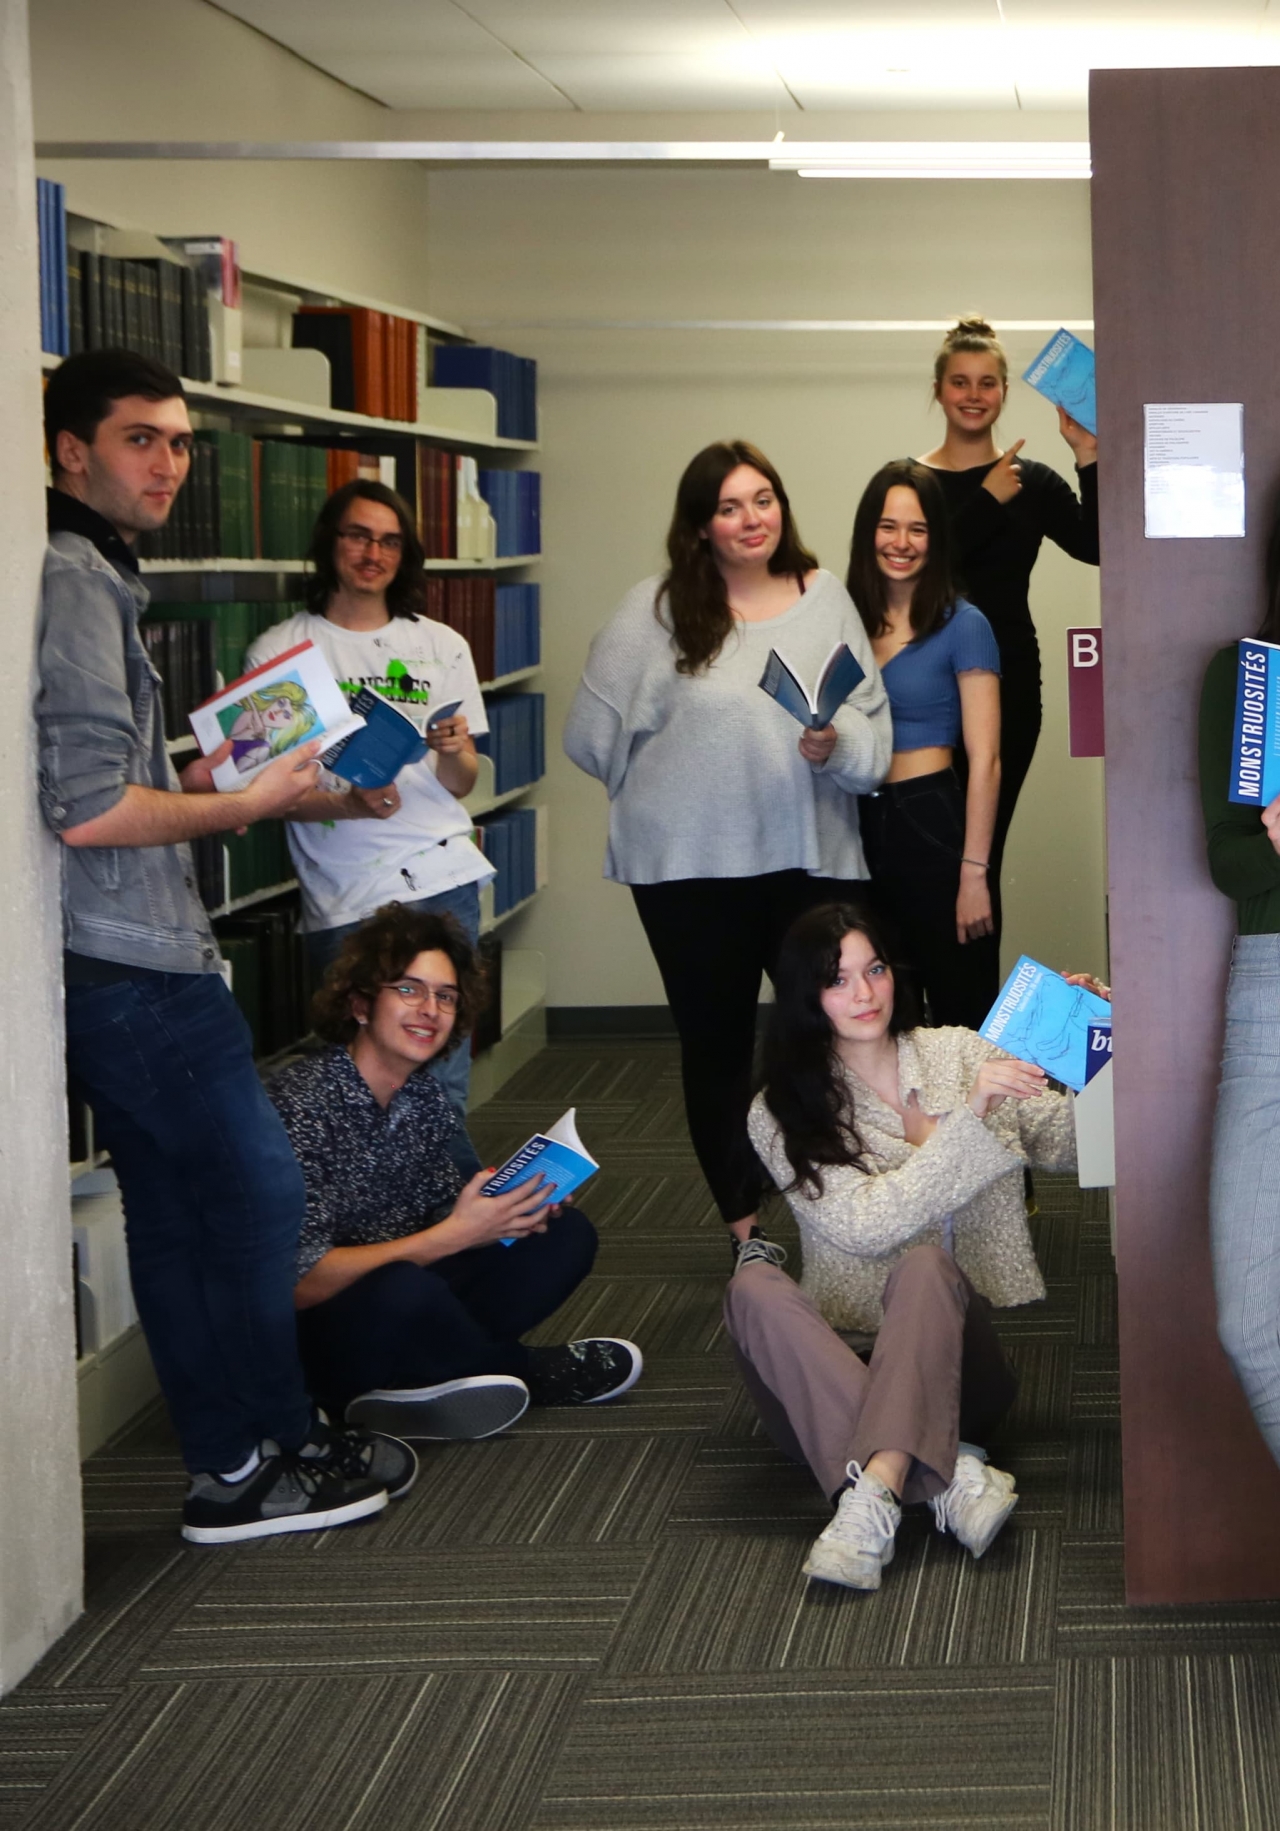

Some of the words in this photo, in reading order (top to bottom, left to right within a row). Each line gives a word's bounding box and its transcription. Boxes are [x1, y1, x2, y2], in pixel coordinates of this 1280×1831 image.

[1073, 634, 1099, 668] B
[1238, 651, 1266, 798] MONSTRUOSITÉS
[985, 962, 1037, 1042] MONSTRUOSITÉS
